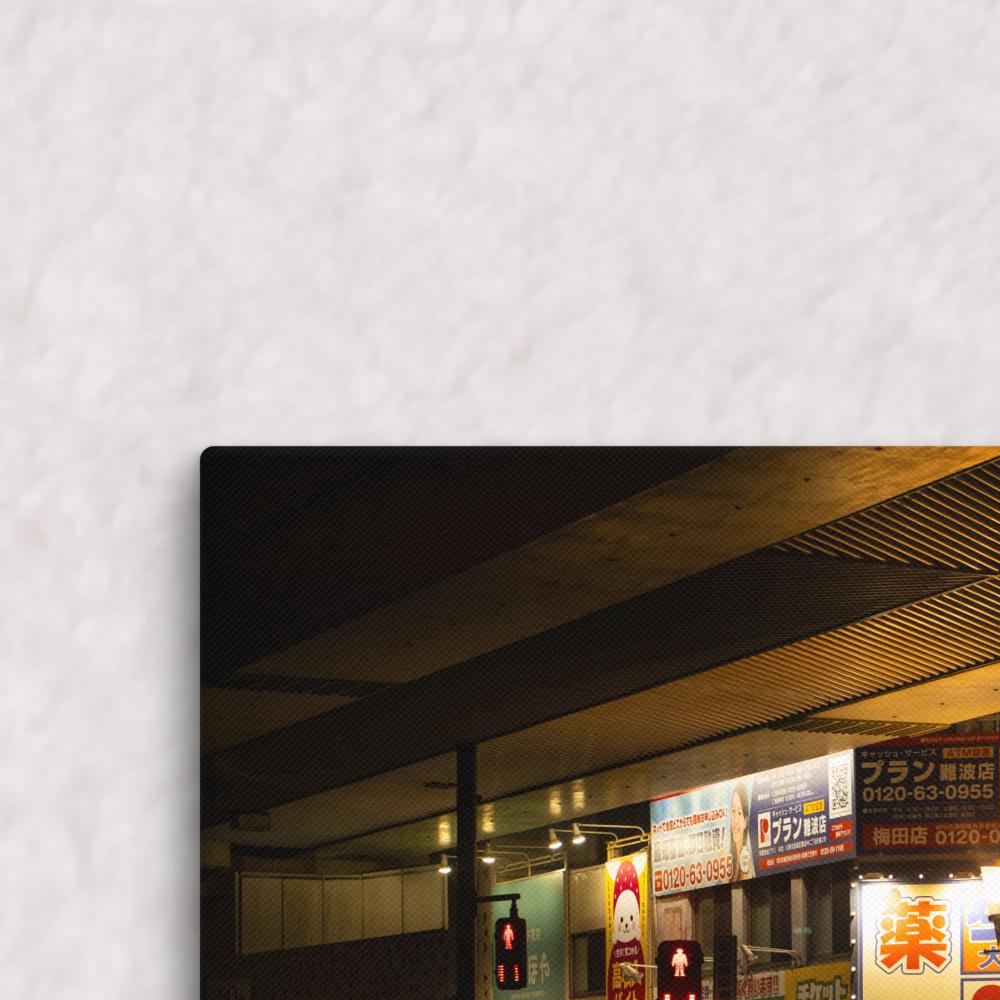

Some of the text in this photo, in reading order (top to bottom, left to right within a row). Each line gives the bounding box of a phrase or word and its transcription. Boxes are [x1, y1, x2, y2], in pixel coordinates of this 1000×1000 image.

[861, 759, 995, 784] プラン 難波店
[862, 784, 994, 802] 0120-63-0955
[772, 815, 803, 845] プラン
[873, 827, 928, 845] 梅田店
[663, 855, 733, 891] 0120-63-0955
[879, 898, 949, 970] 薬
